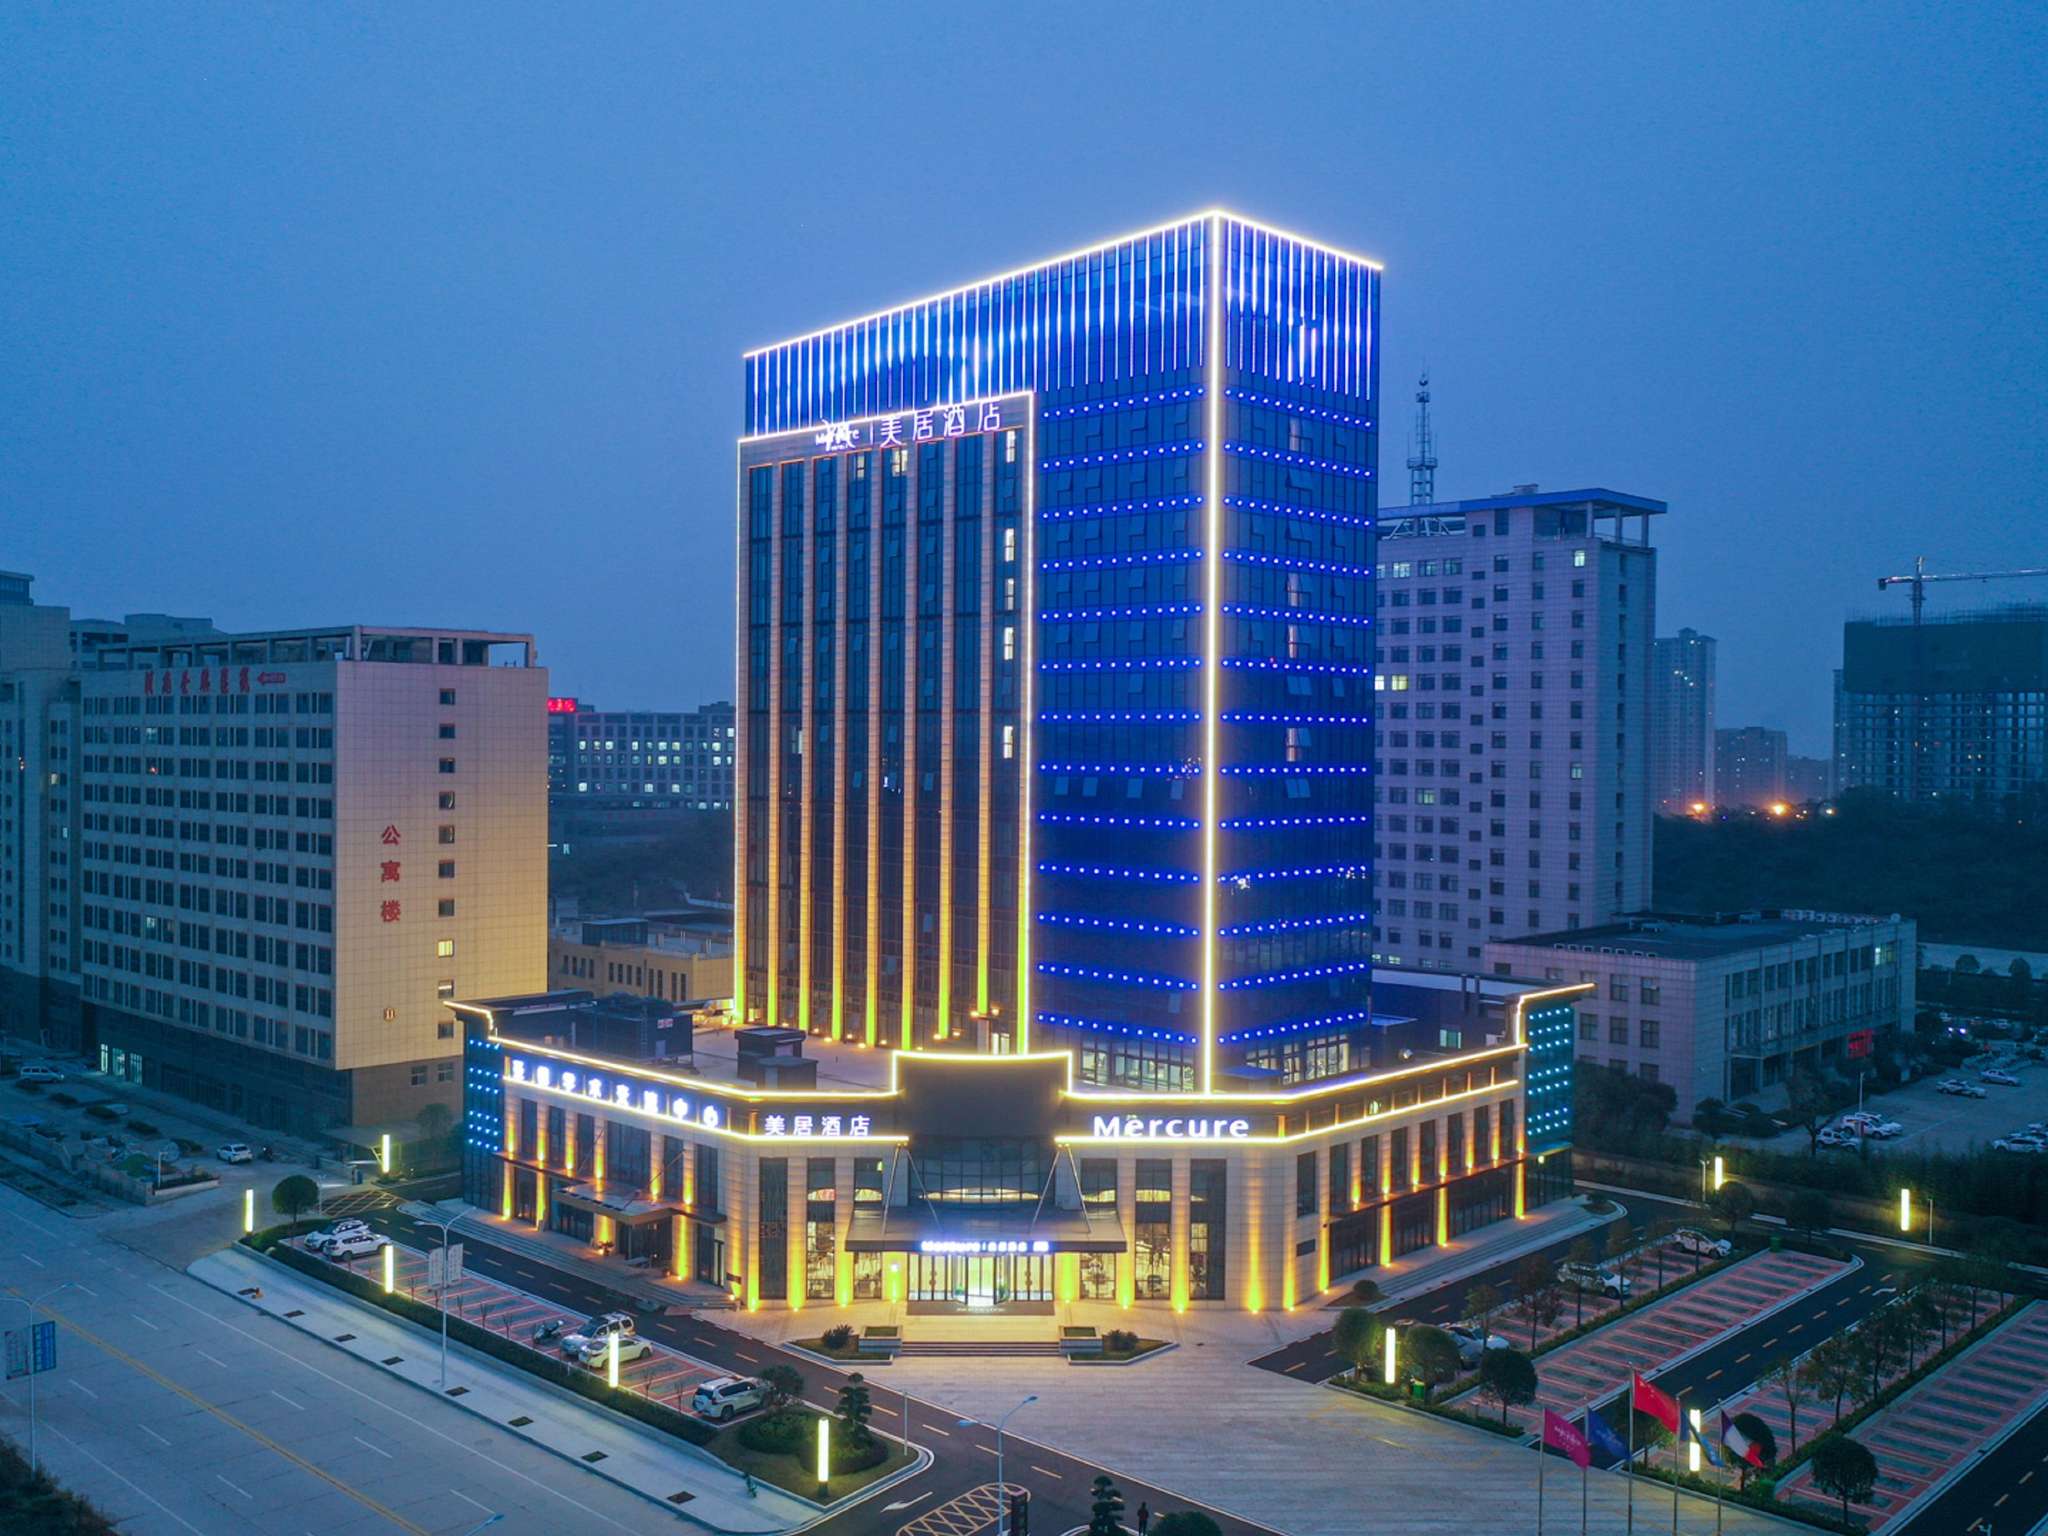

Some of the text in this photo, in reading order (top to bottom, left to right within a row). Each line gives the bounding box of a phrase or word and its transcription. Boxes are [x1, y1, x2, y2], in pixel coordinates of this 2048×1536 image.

[880, 401, 1001, 447] 美居酒店
[380, 824, 401, 922] 公寓楼
[764, 1114, 871, 1136] 美居酒店
